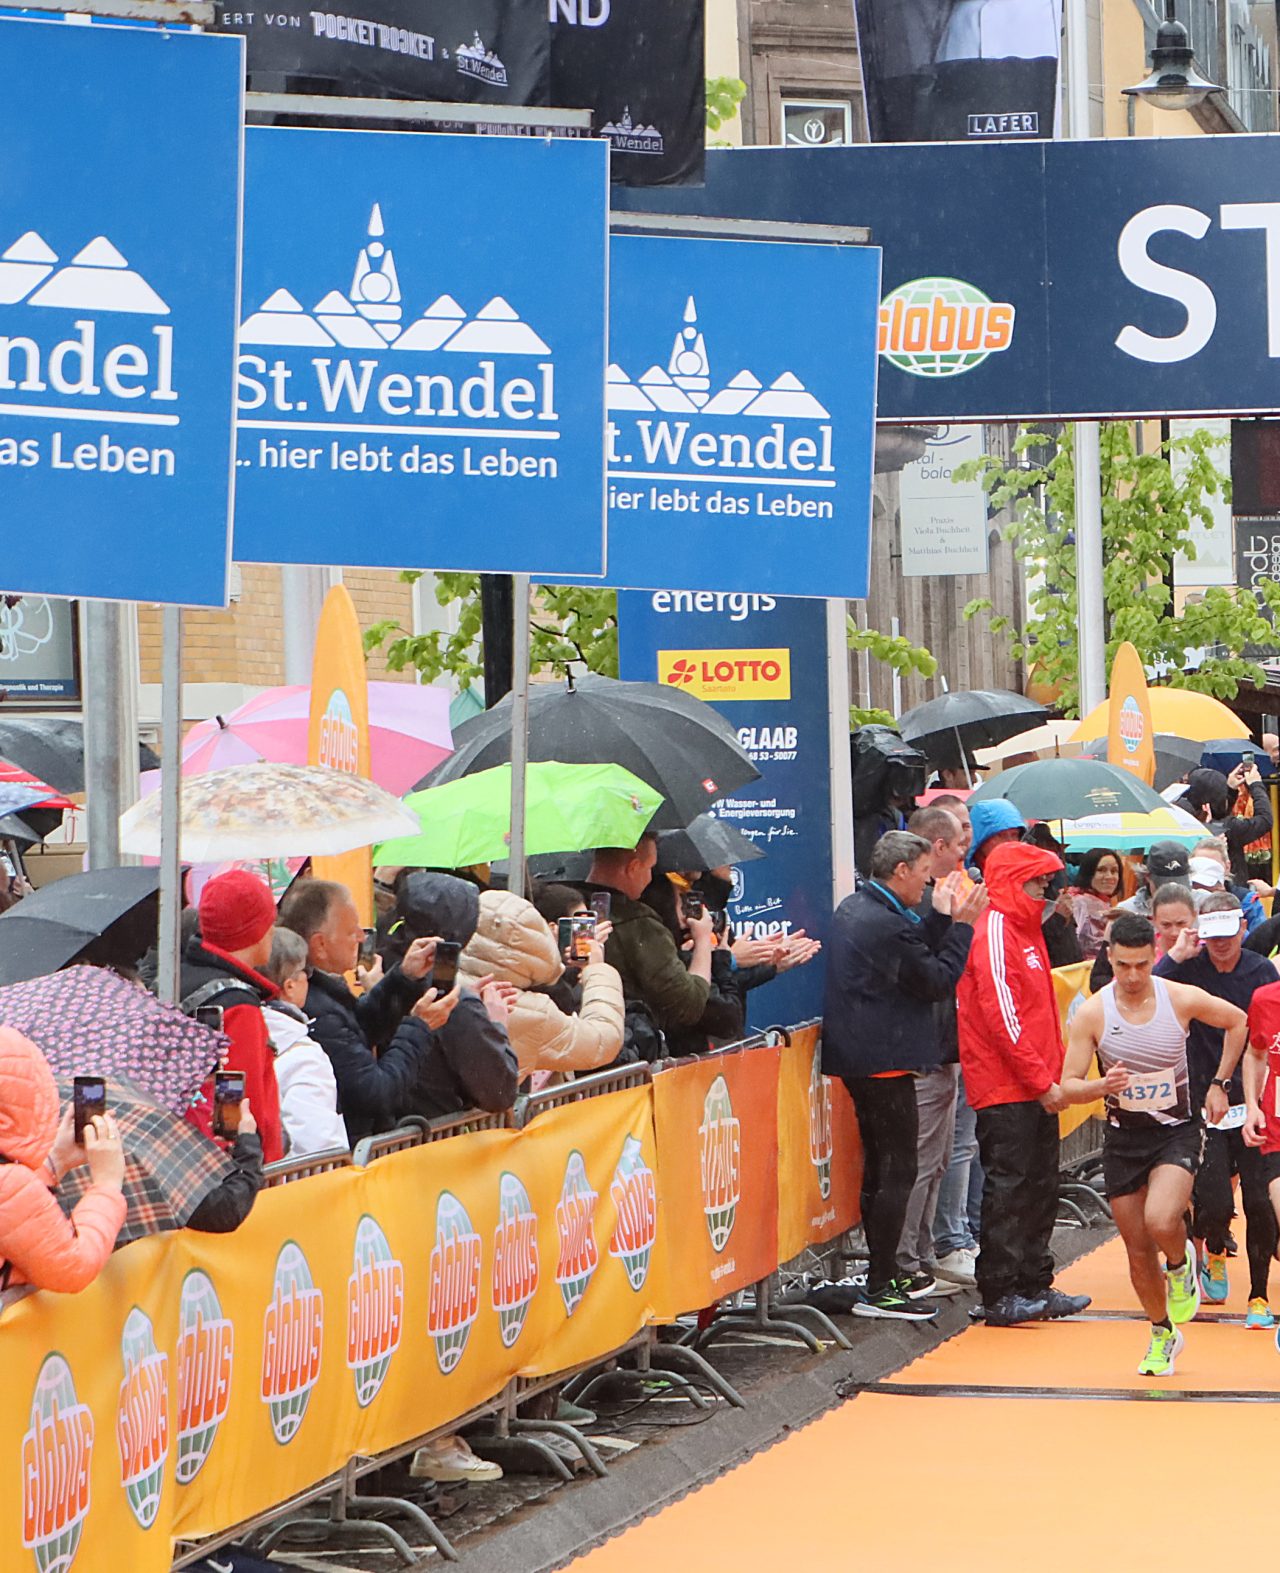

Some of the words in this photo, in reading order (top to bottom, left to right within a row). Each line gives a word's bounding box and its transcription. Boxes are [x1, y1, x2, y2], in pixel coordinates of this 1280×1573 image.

[265, 14, 301, 28] VON
[973, 114, 1033, 132] LAFER
[51, 431, 176, 476] Leben
[259, 438, 323, 469] hier
[331, 441, 393, 472] lebt
[400, 444, 455, 475] das
[463, 447, 558, 478] Leben
[606, 419, 836, 472] t.Wendel
[920, 467, 952, 480] bala
[608, 486, 645, 510] ier
[651, 487, 700, 513] lebt
[706, 490, 750, 515] das
[756, 492, 833, 519] Leben
[652, 591, 777, 621] energis
[702, 661, 781, 682] LOTTO
[737, 727, 798, 750] GLAAB
[719, 808, 796, 819] Energieversorgung
[760, 798, 777, 808] und
[1121, 1082, 1172, 1101] 4372
[491, 1200, 539, 1313] Globus
[428, 1221, 483, 1337] Globus
[346, 1249, 404, 1369] Globus
[261, 1277, 324, 1404] Globus
[22, 1394, 95, 1549] Globus
